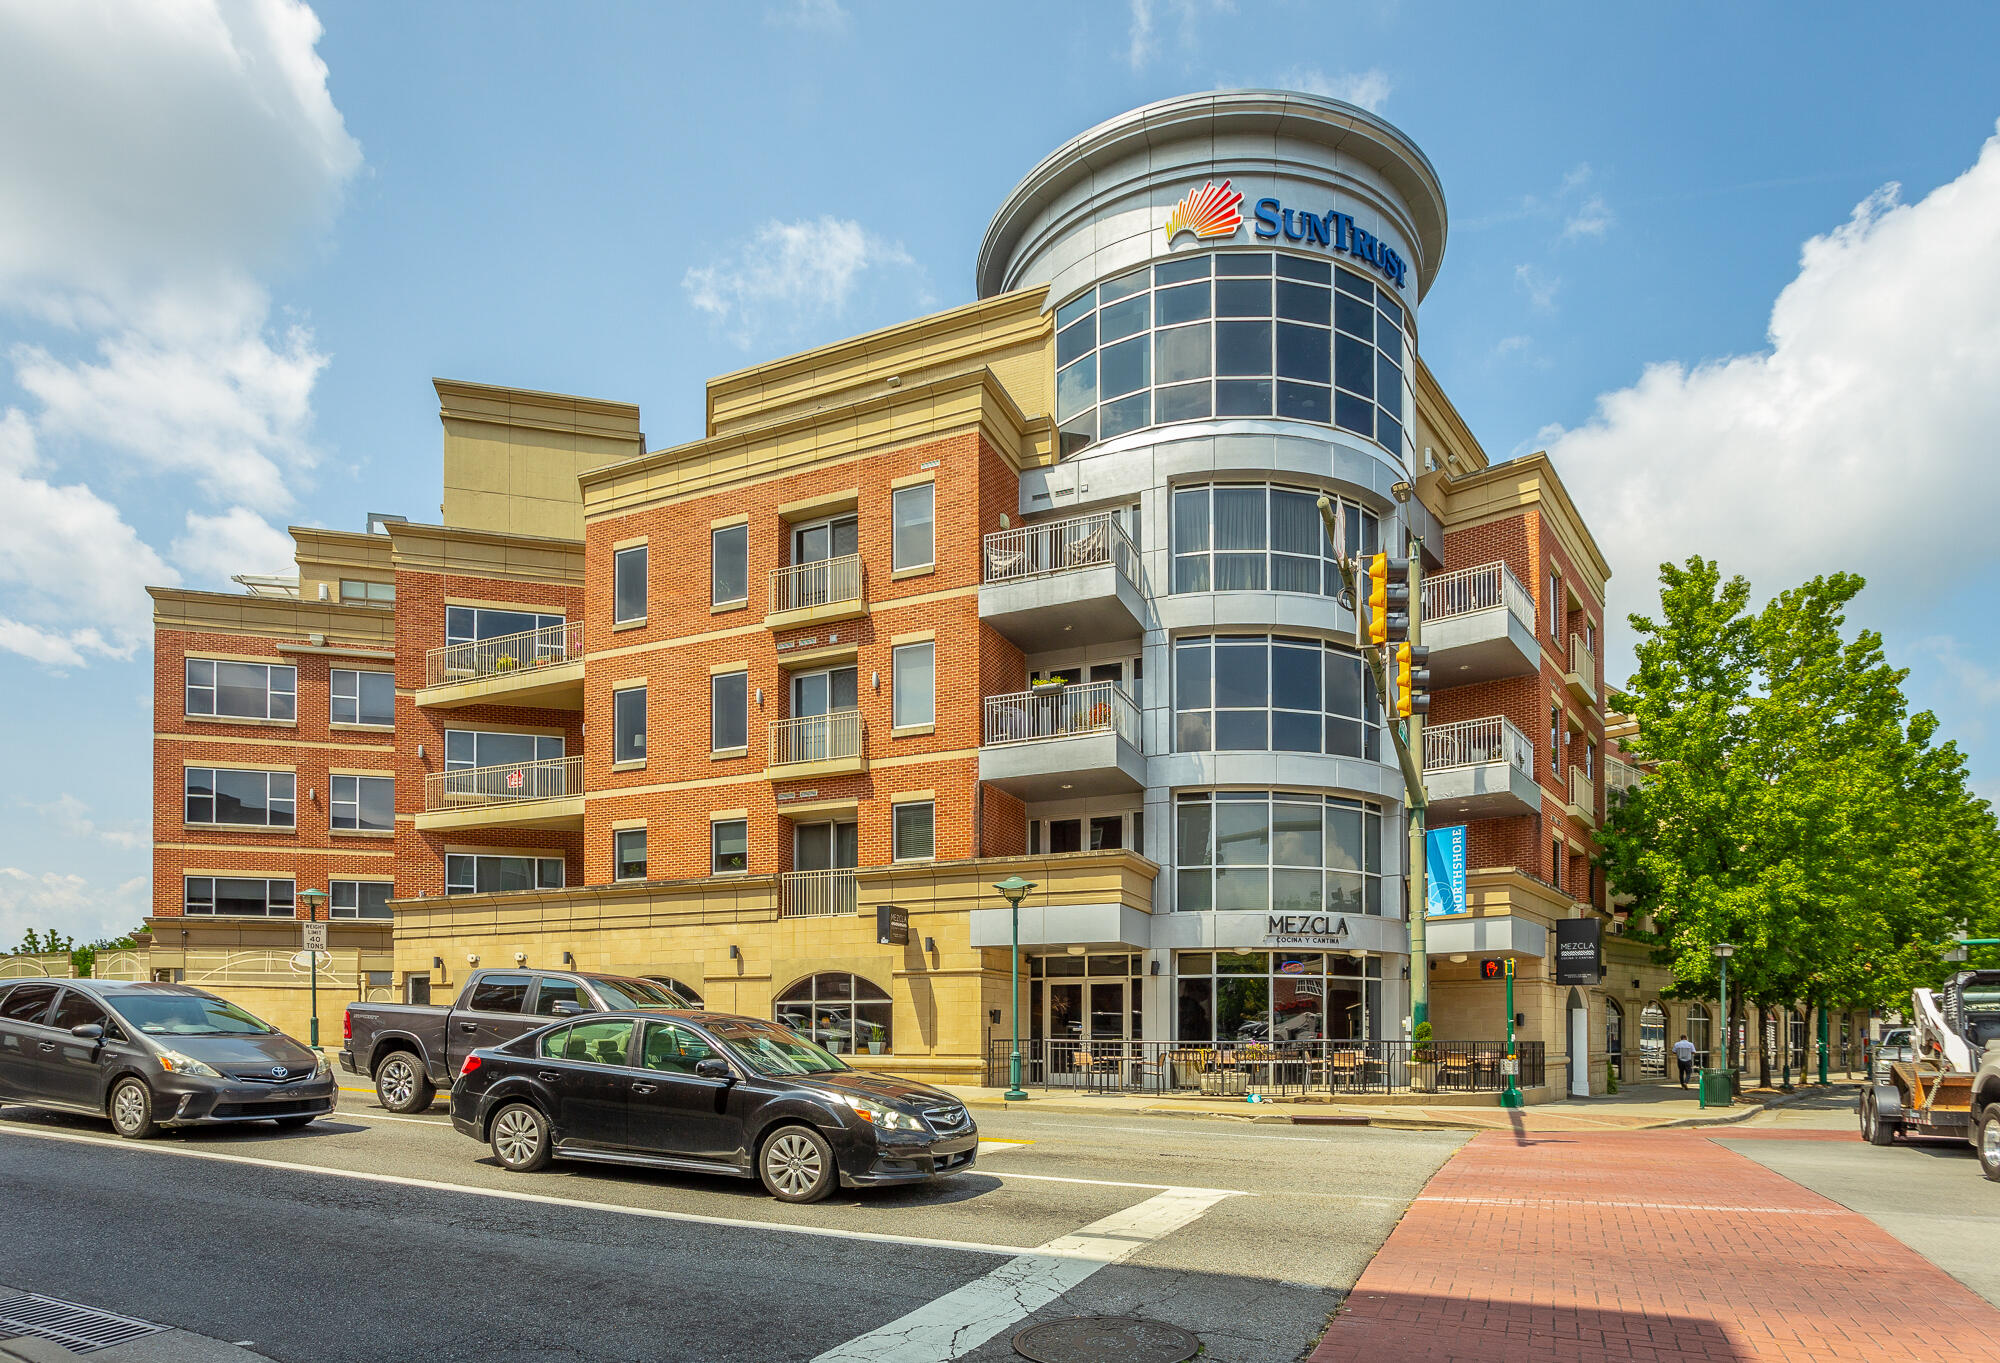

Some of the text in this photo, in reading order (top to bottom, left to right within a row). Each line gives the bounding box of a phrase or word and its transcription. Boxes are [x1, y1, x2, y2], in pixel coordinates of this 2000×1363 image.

[1452, 828, 1463, 912] NORTHSHORE
[1268, 915, 1349, 935] MEZCLA
[1560, 942, 1595, 950] MEZCLA
